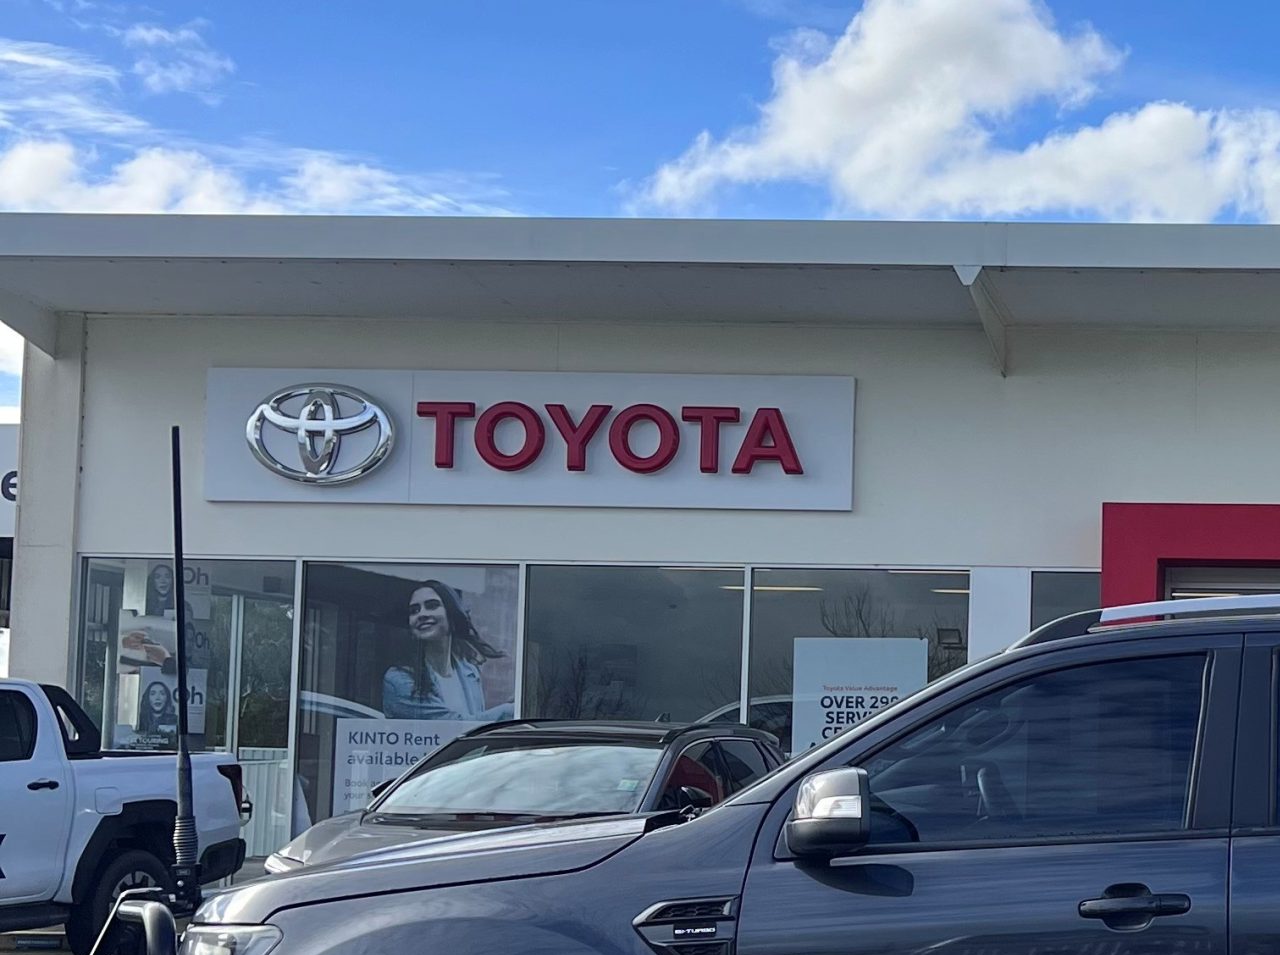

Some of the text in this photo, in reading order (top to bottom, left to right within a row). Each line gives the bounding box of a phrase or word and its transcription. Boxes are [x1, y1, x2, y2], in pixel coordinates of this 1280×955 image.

[417, 401, 803, 475] TOYOTA
[820, 695, 866, 709] OVER
[825, 711, 872, 725] SERV
[348, 731, 441, 746] KINTO Rent
[347, 752, 420, 766] available
